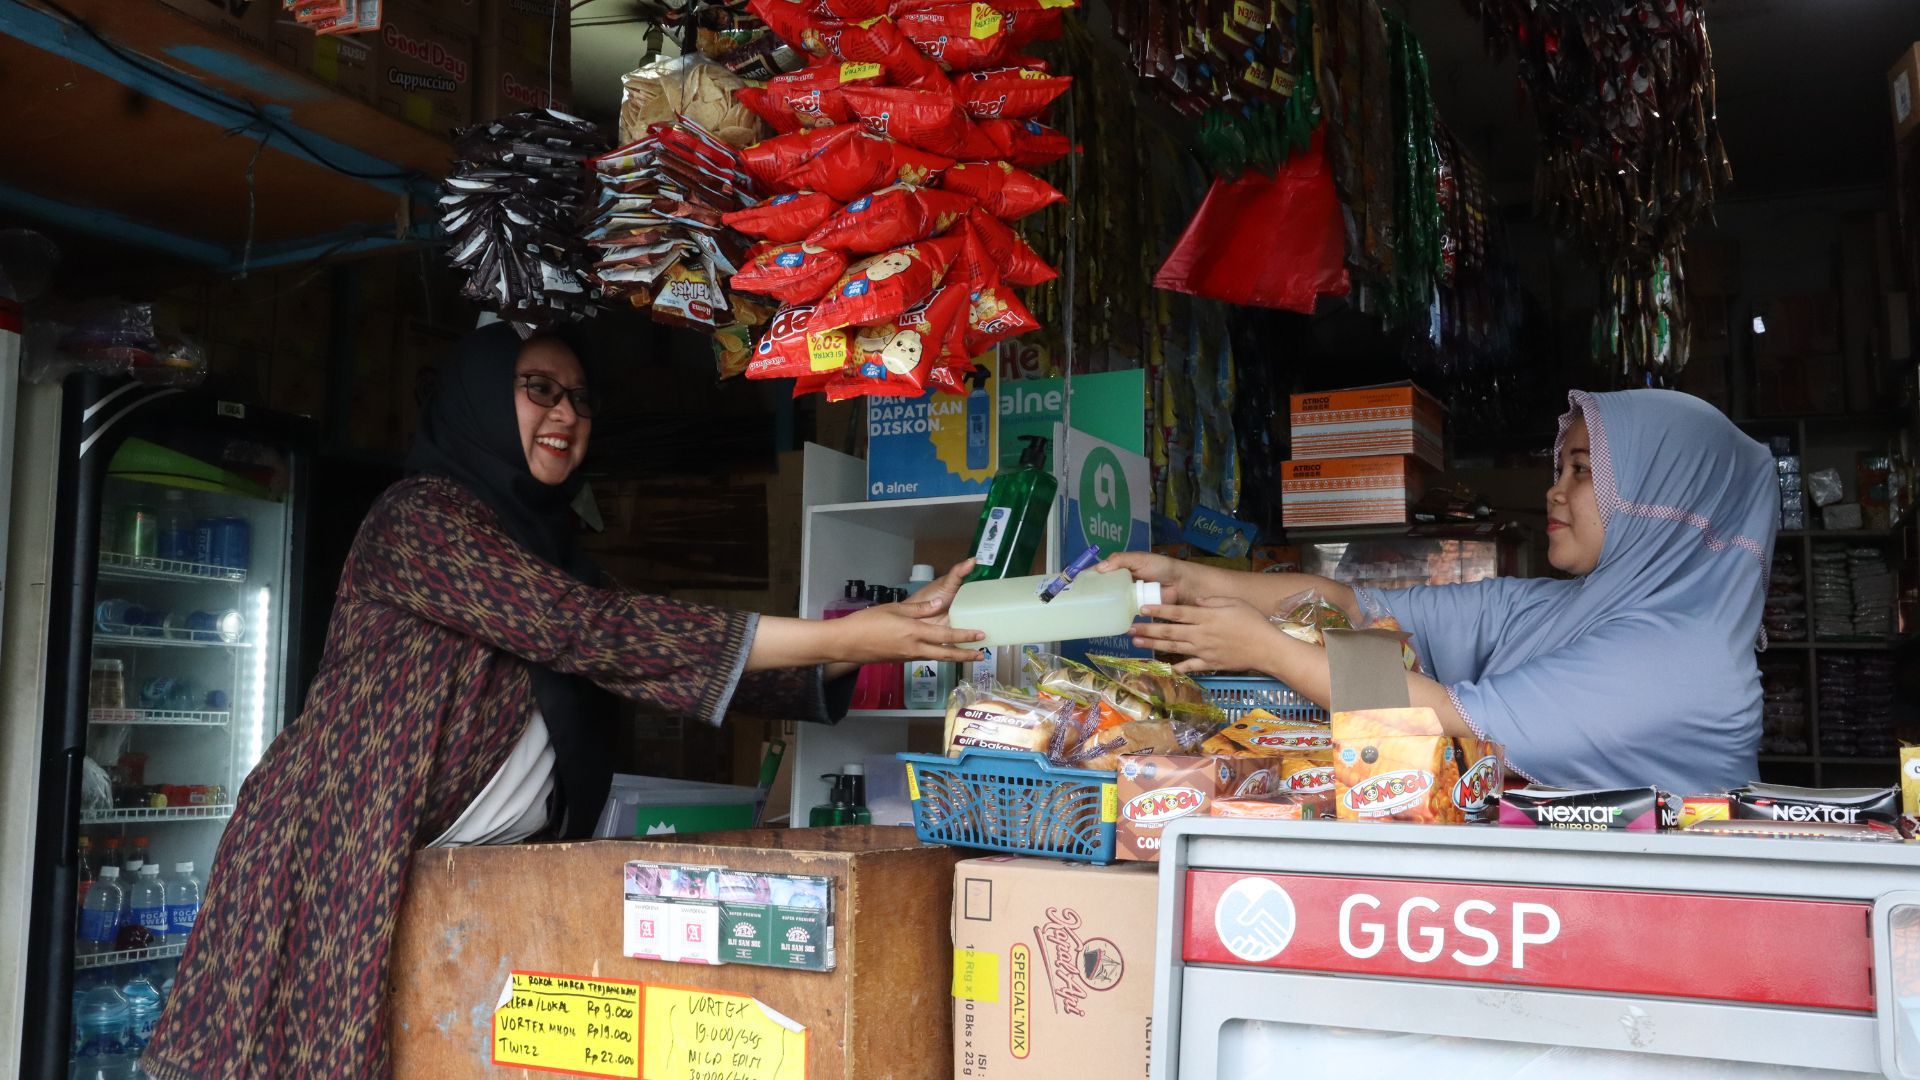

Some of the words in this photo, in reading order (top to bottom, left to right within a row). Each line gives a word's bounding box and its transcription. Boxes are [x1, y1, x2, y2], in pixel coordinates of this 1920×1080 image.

[383, 22, 432, 64] Good
[430, 40, 468, 85] Day
[387, 66, 457, 94] Cappuccino
[503, 72, 538, 107] Good
[900, 312, 926, 326] NET
[811, 334, 843, 351] 20%
[870, 400, 963, 422] DAPATKAN
[870, 418, 945, 437] DISKON.
[886, 481, 919, 494] alner
[1089, 515, 1123, 541] alner
[984, 711, 1027, 727] bakery
[1338, 893, 1561, 969] GGSP
[1013, 952, 1025, 1015] SPECIAL
[587, 1000, 600, 1017] Rp
[603, 1003, 633, 1019] 9.000
[688, 995, 751, 1018] VORTEX
[500, 1015, 546, 1033] VORTEX
[587, 1023, 599, 1038] Rp
[965, 1013, 975, 1037] Bks
[1013, 1020, 1025, 1051] MIX
[965, 1040, 973, 1048] x
[585, 1047, 599, 1065] Rp
[600, 1050, 635, 1066] 22.000
[977, 1053, 988, 1072] ISI
